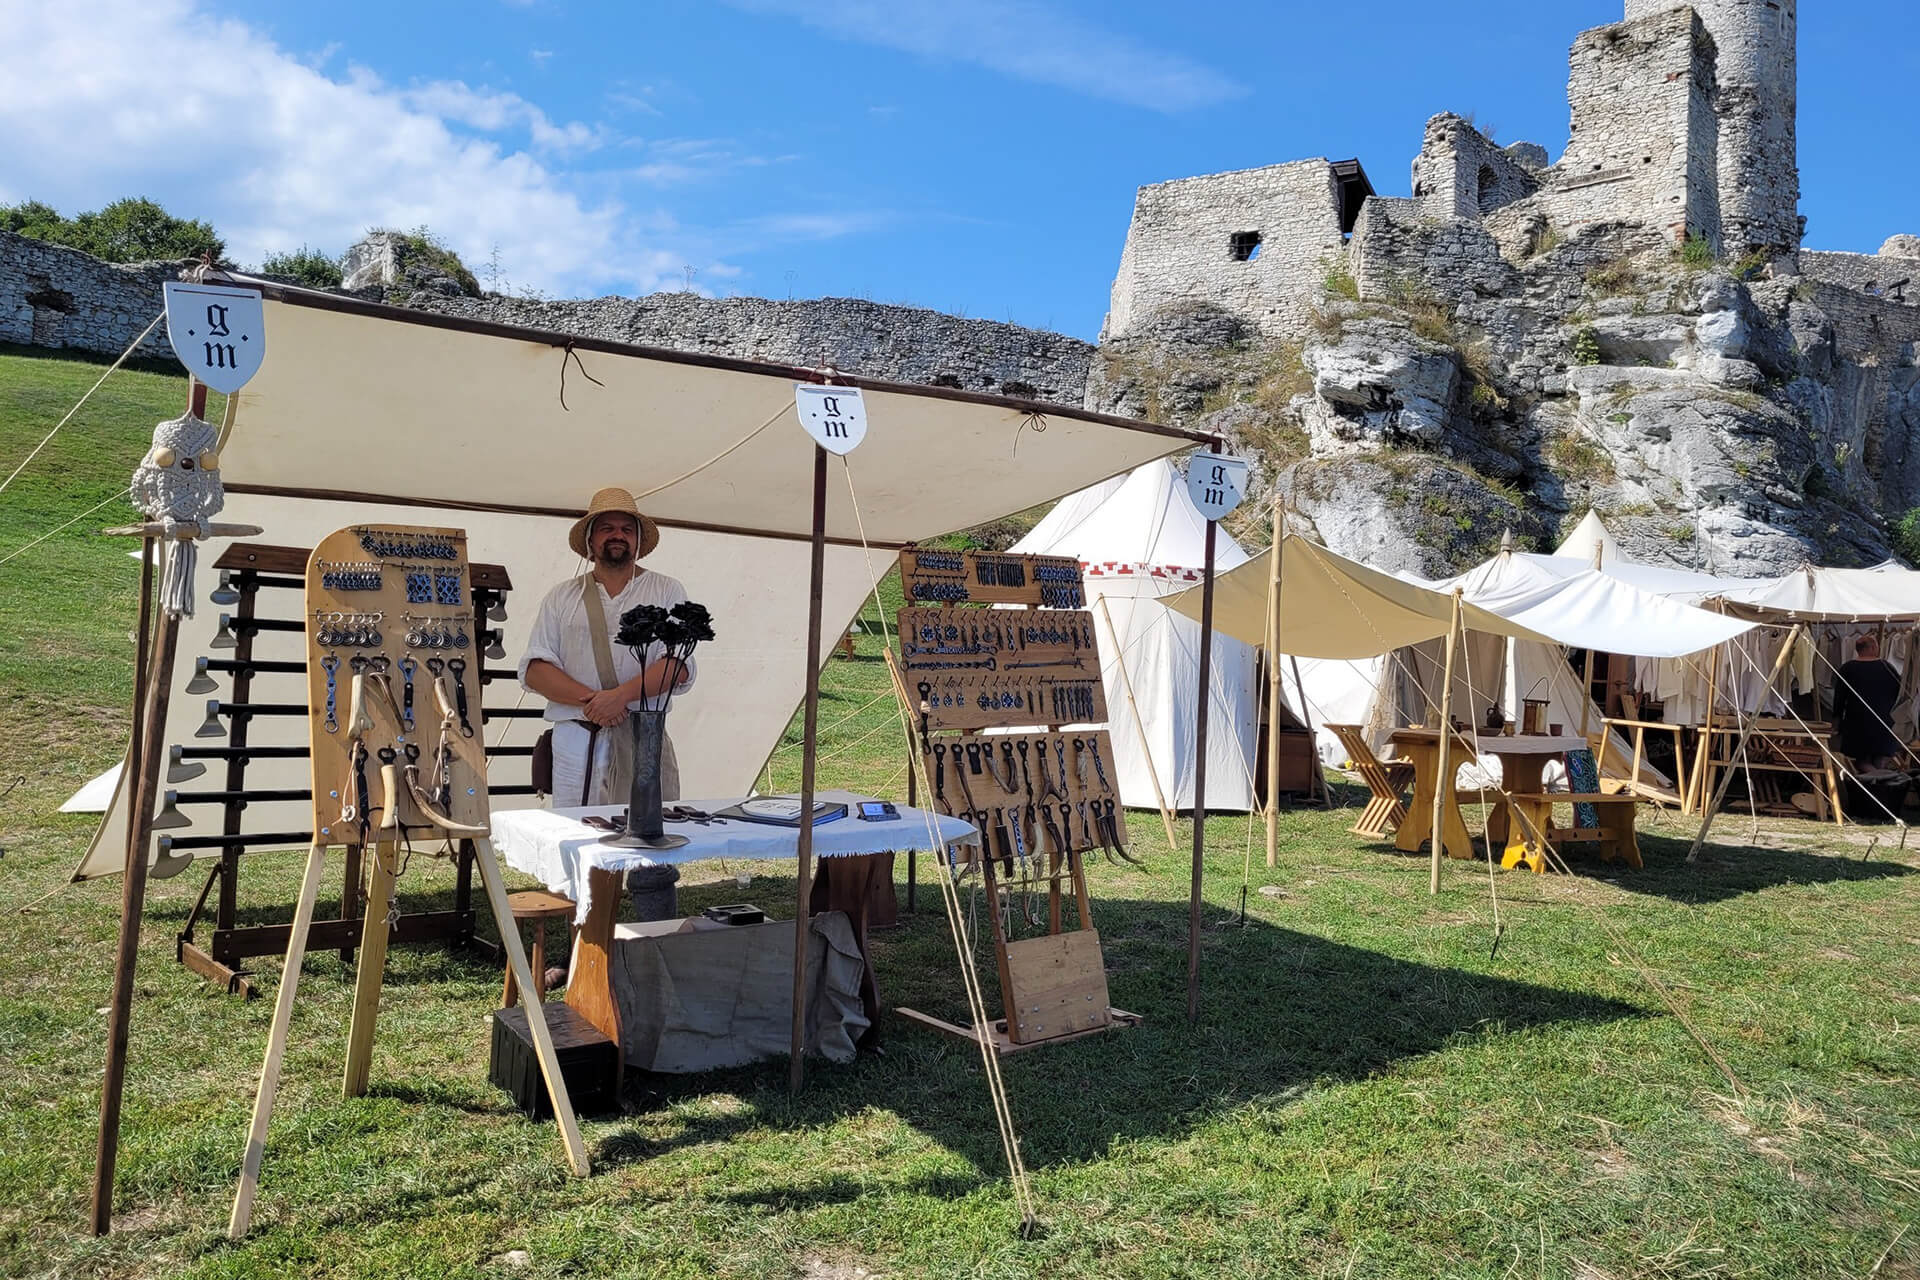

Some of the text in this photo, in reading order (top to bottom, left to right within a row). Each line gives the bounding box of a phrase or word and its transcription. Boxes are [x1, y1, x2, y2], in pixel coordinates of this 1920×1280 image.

[203, 341, 238, 370] m
[824, 420, 848, 438] m
[1204, 488, 1224, 506] m
